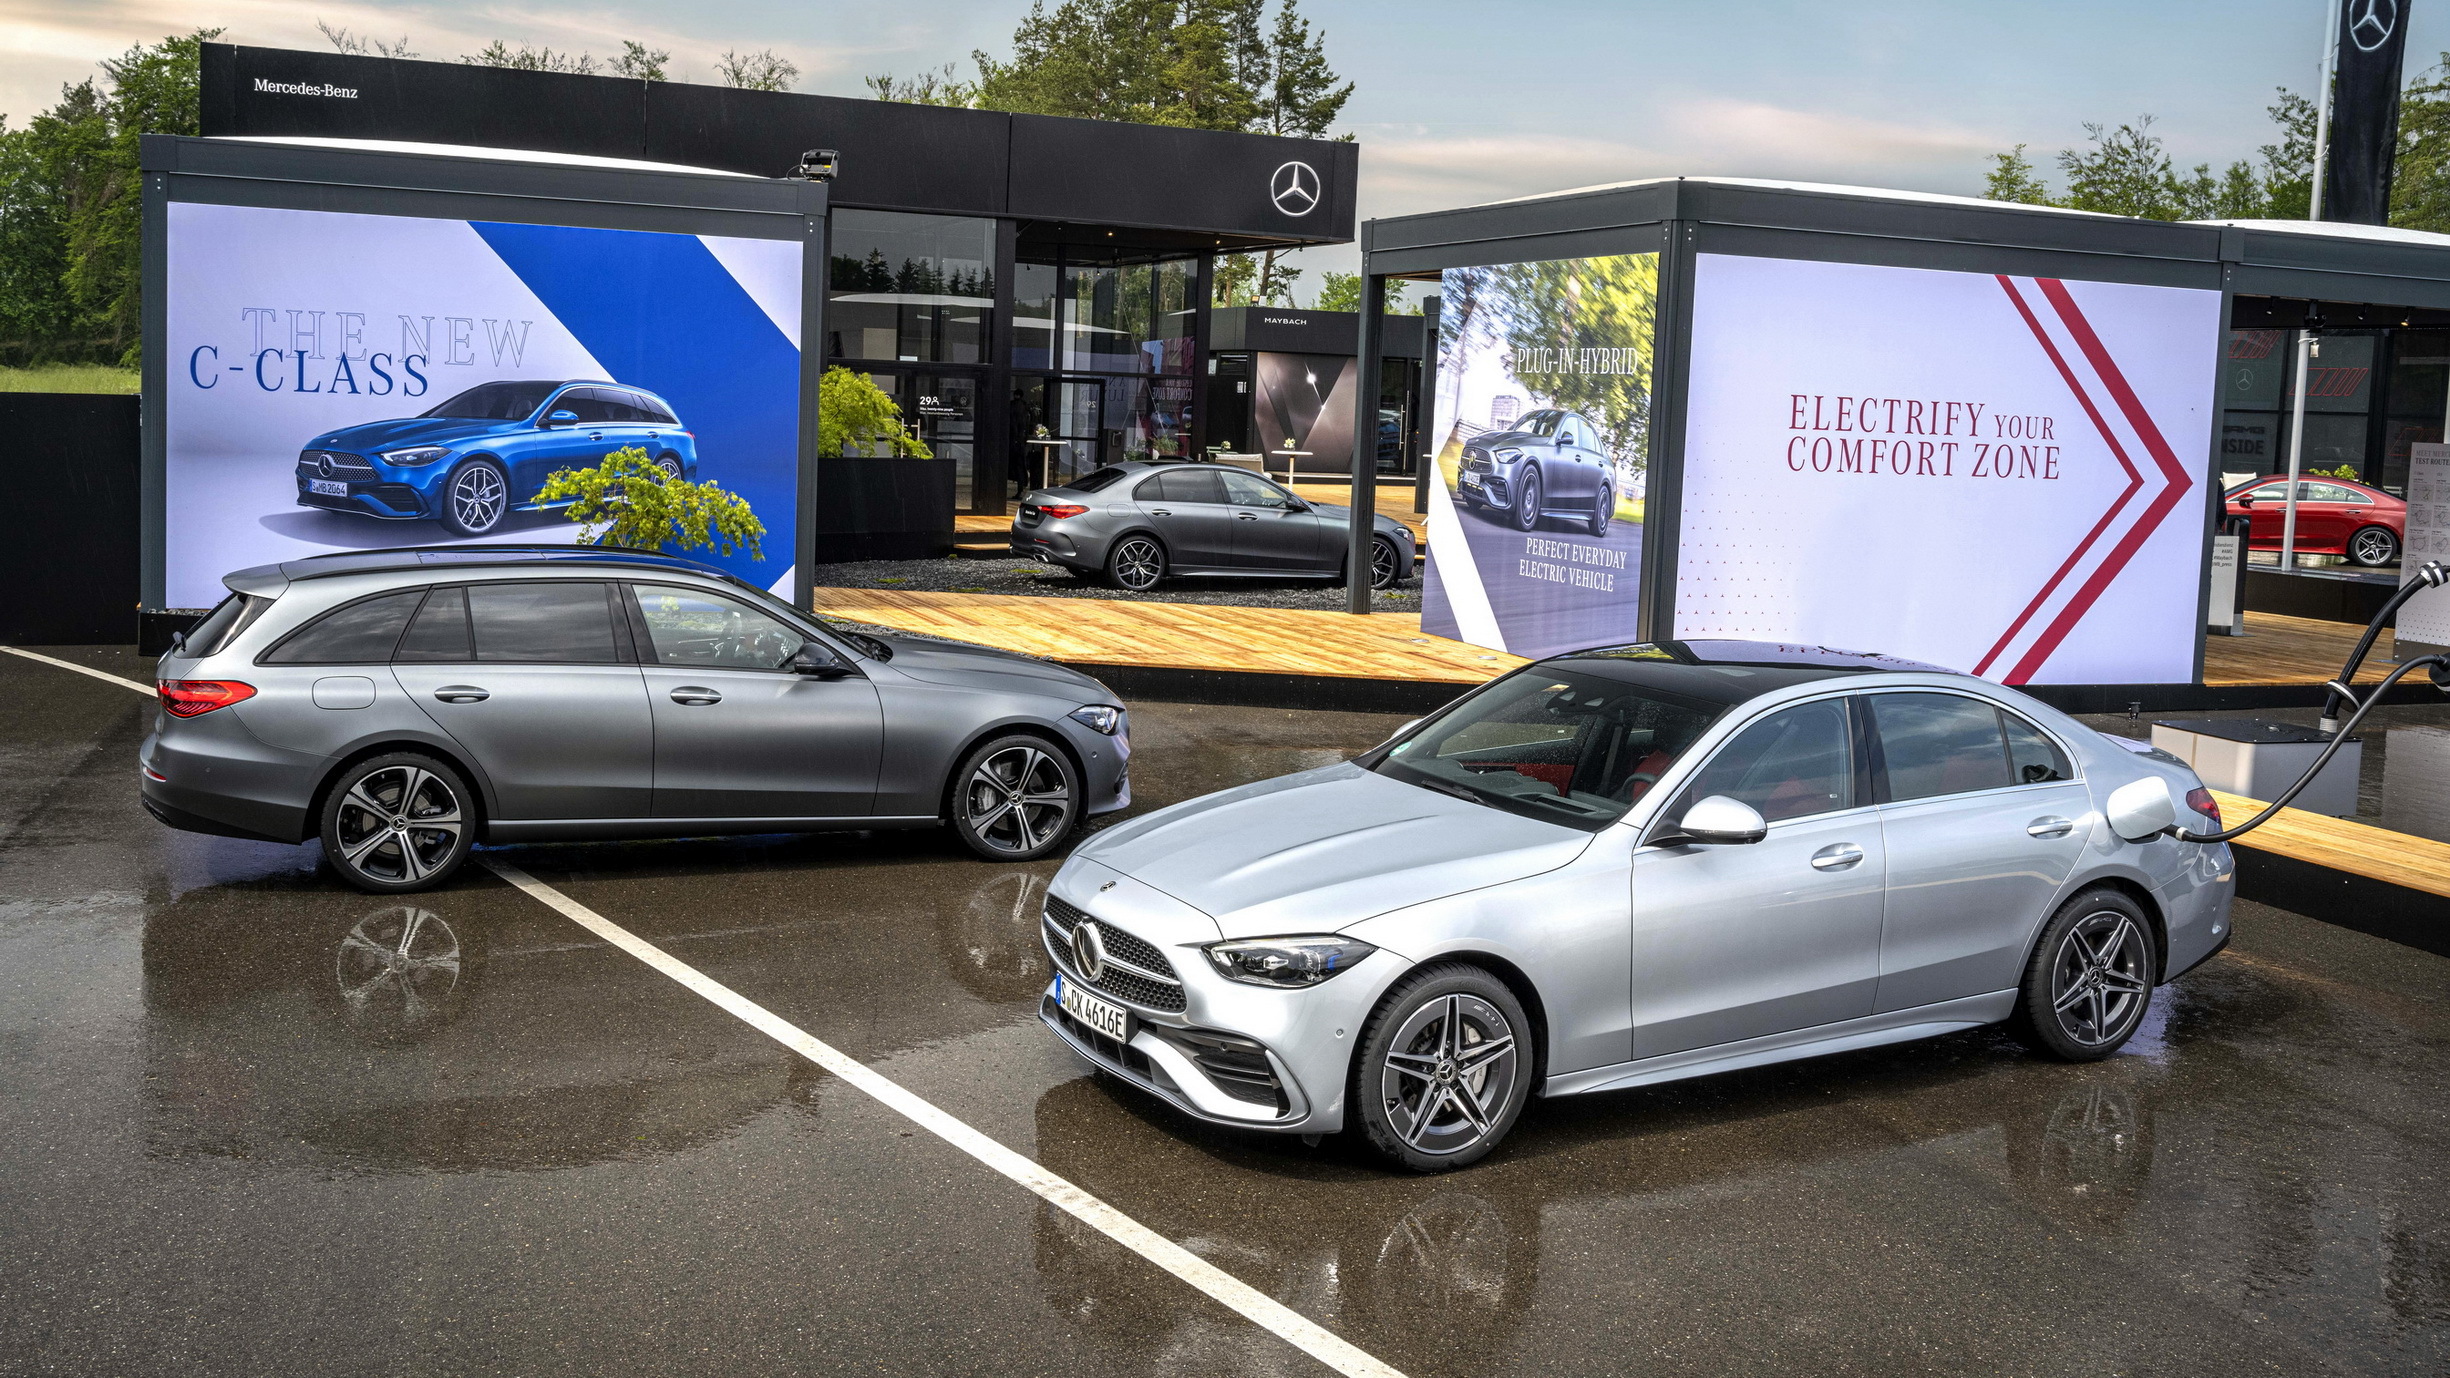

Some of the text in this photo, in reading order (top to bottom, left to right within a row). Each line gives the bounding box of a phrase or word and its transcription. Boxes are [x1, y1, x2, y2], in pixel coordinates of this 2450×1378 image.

[254, 78, 358, 98] Mercedes-Benz
[1264, 317, 1307, 325] MAYBACH
[241, 307, 533, 368] THE NEW
[189, 345, 429, 397] C-CLASS
[1516, 347, 1638, 376] PLUG-IN-HYBRID
[919, 396, 931, 405] 29
[1789, 393, 2055, 440] ELECTRIFY YOUR
[1787, 435, 2060, 480] COMFORT ZONE
[2415, 457, 2450, 466] TEST ROUTE
[1526, 537, 1628, 569] PERFECT EVERYDAY
[1519, 559, 1614, 592] ELECTRIC VEHICLE
[1086, 999, 1123, 1037] 4616E
